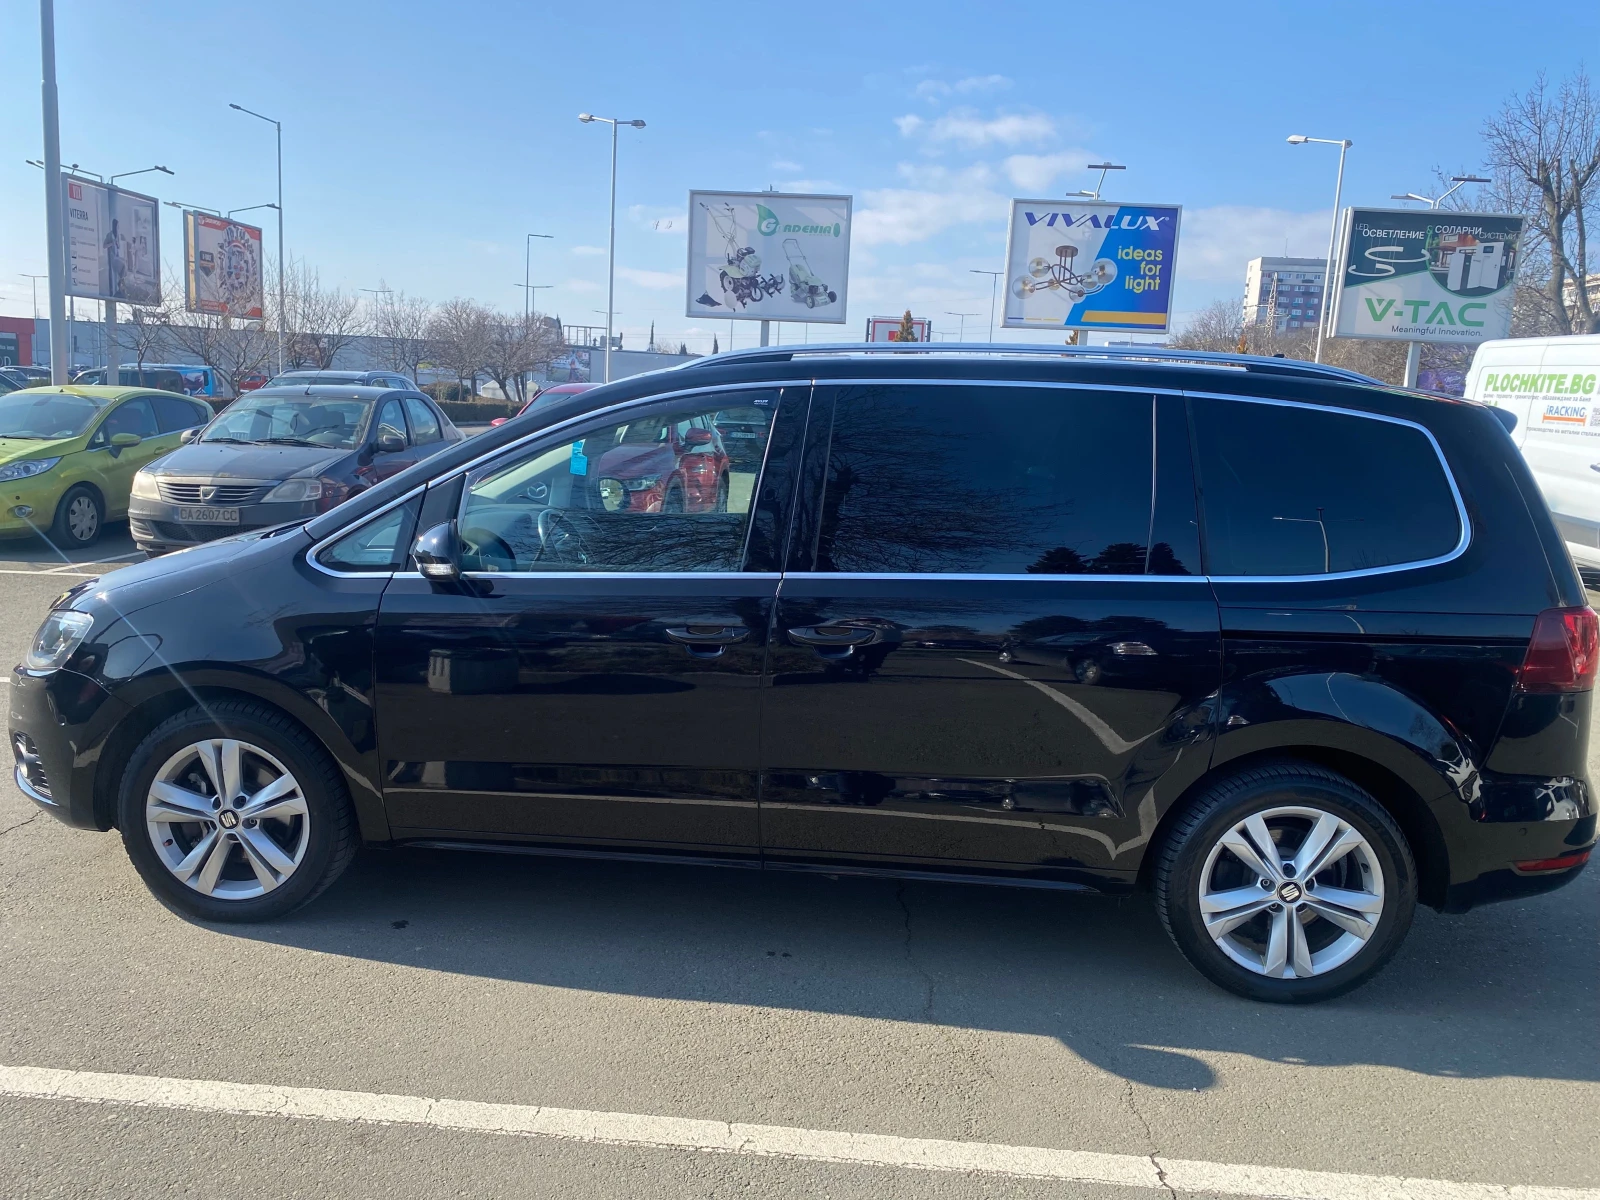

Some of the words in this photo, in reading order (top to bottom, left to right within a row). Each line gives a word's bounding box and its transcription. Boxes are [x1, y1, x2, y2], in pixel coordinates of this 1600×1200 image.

[69, 208, 88, 221] VITERRA
[1355, 223, 1369, 231] LED
[1434, 225, 1483, 235] СОЛАРНИ
[1362, 229, 1426, 240] ОСВЕТЛЕНИЕ
[1479, 231, 1517, 240] СИСТЕМИ
[1117, 245, 1163, 261] ideas
[1140, 261, 1162, 276] for
[1125, 275, 1160, 294] light
[1365, 298, 1487, 327] V-TAC
[1391, 325, 1436, 336] Meaningful
[1439, 327, 1483, 337] Innovation.
[1485, 374, 1596, 394] PLOCHKITE.BG
[180, 509, 194, 520] CA
[196, 509, 219, 521] 2607
[223, 510, 237, 521] CC
